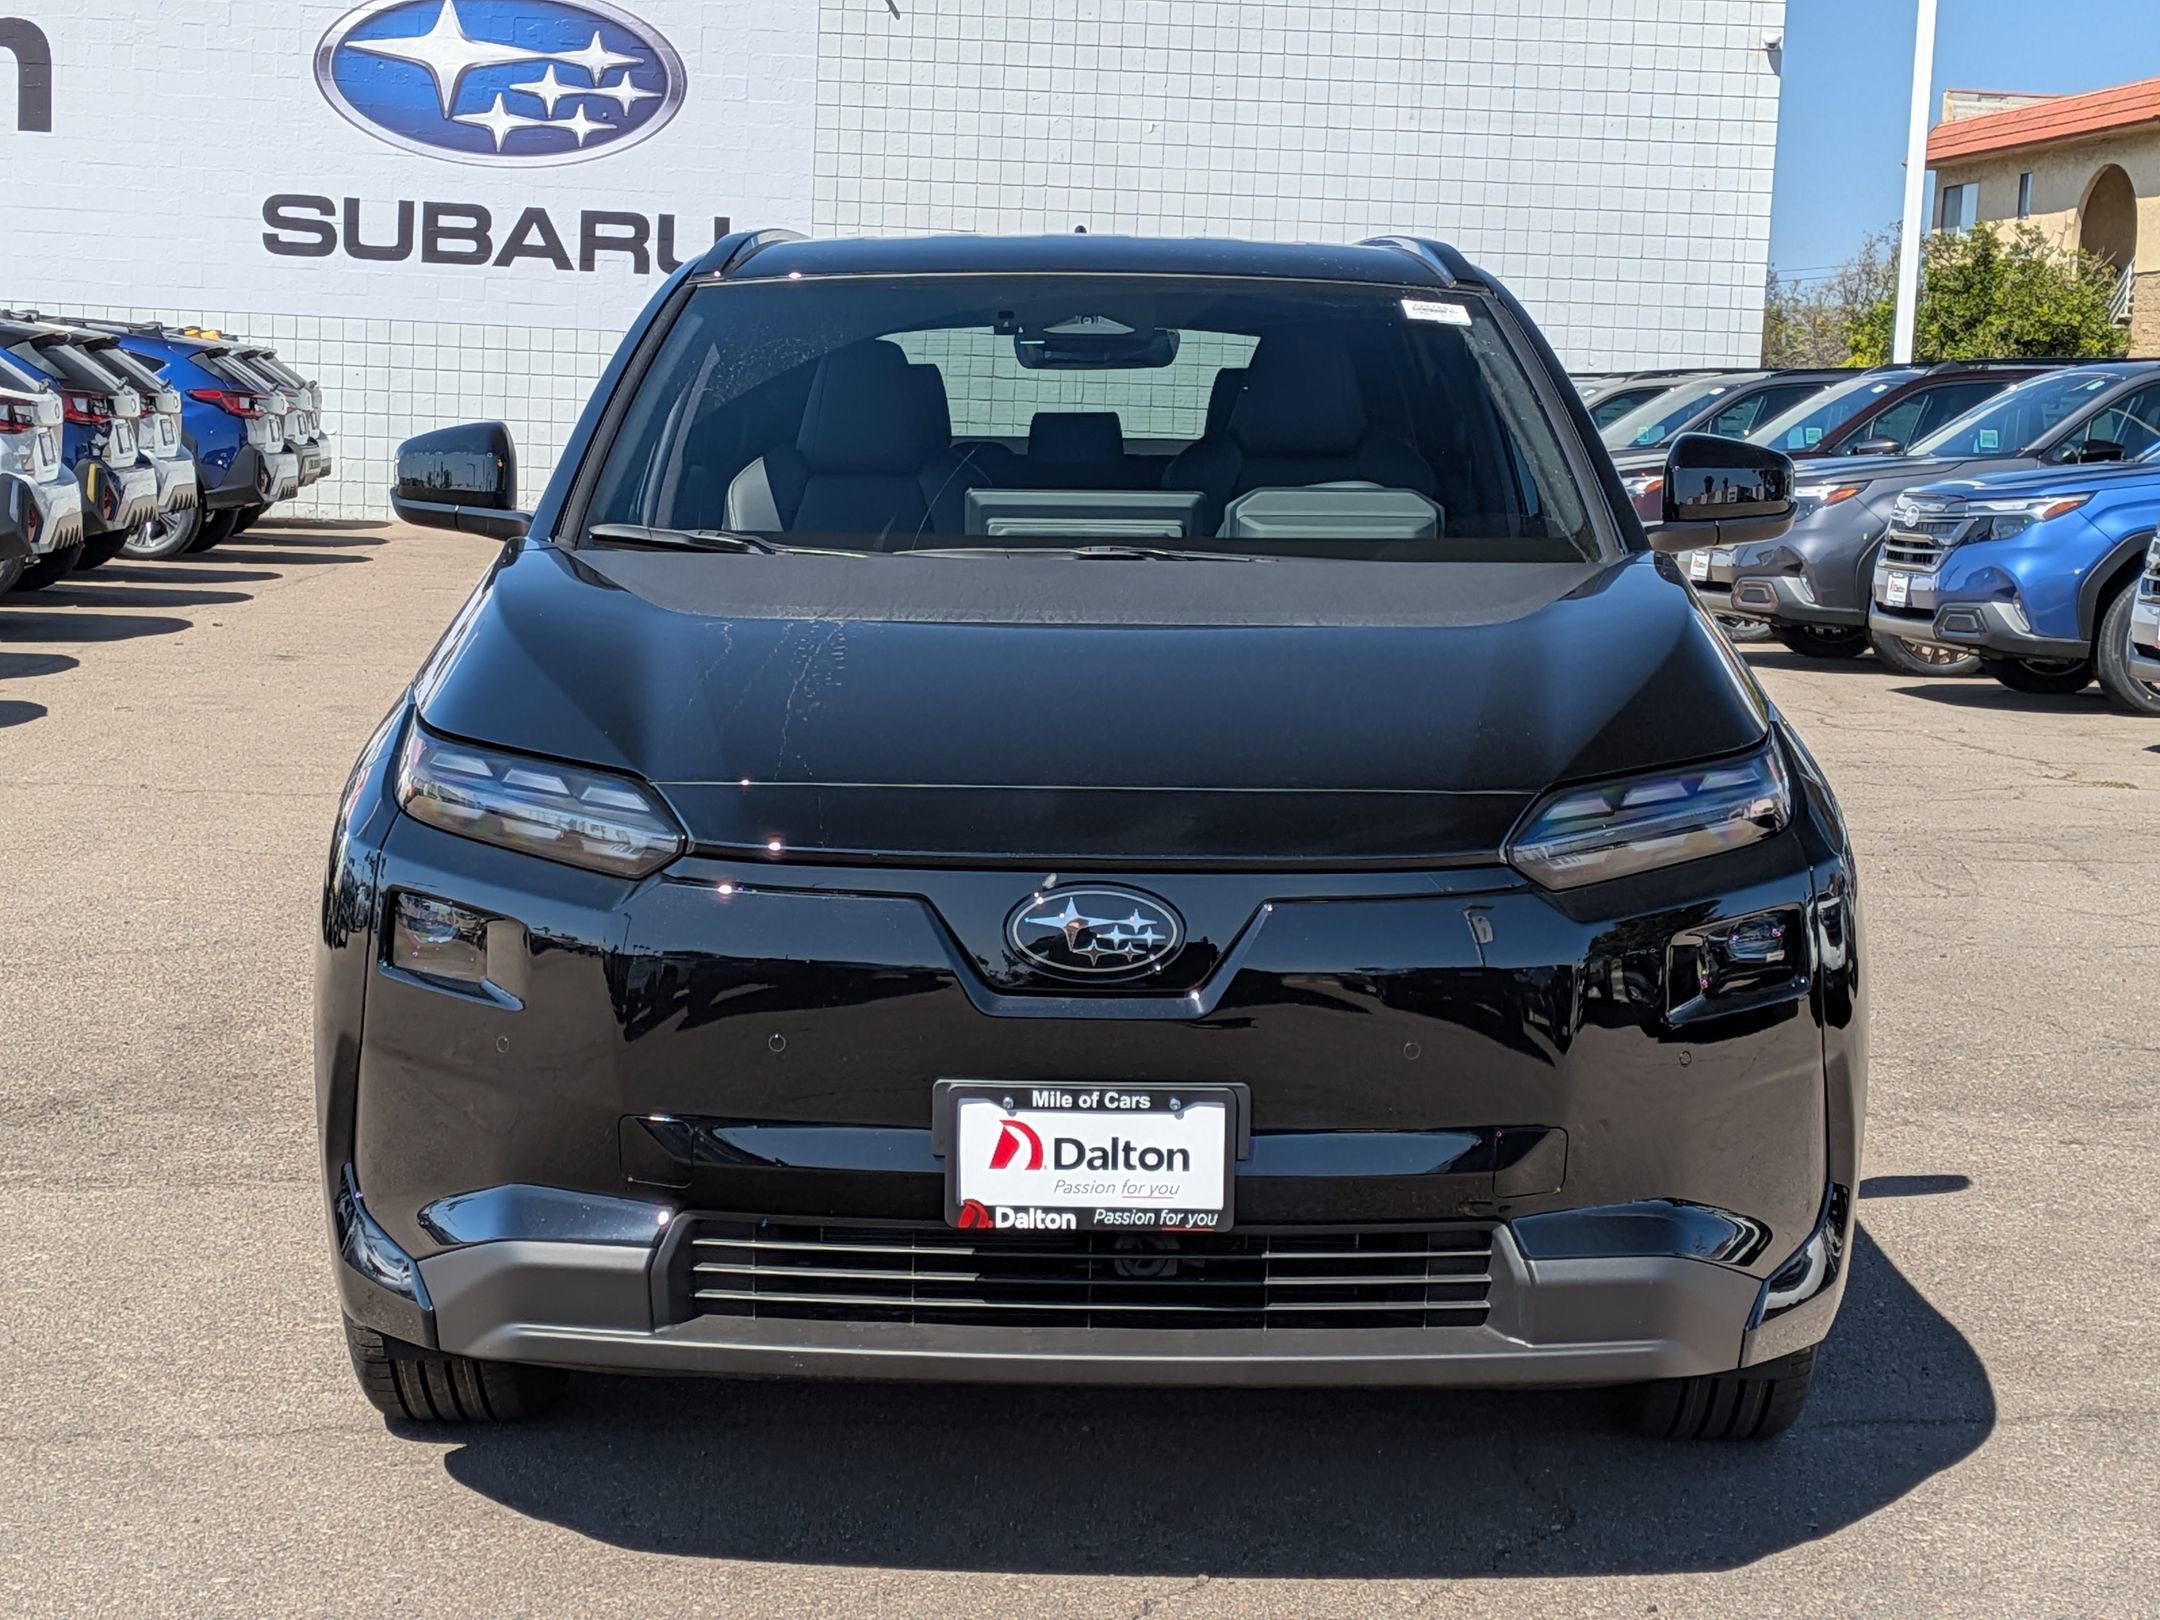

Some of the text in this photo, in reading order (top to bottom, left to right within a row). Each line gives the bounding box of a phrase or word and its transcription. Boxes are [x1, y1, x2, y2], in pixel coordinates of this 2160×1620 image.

[262, 193, 730, 274] SUBARU
[1032, 1090, 1151, 1109] Mile of Cars
[1053, 1137, 1190, 1172] Dalton
[1054, 1179, 1180, 1197] Passion for you
[995, 1208, 1076, 1230] Dalton
[1094, 1210, 1217, 1228] Passion for you
